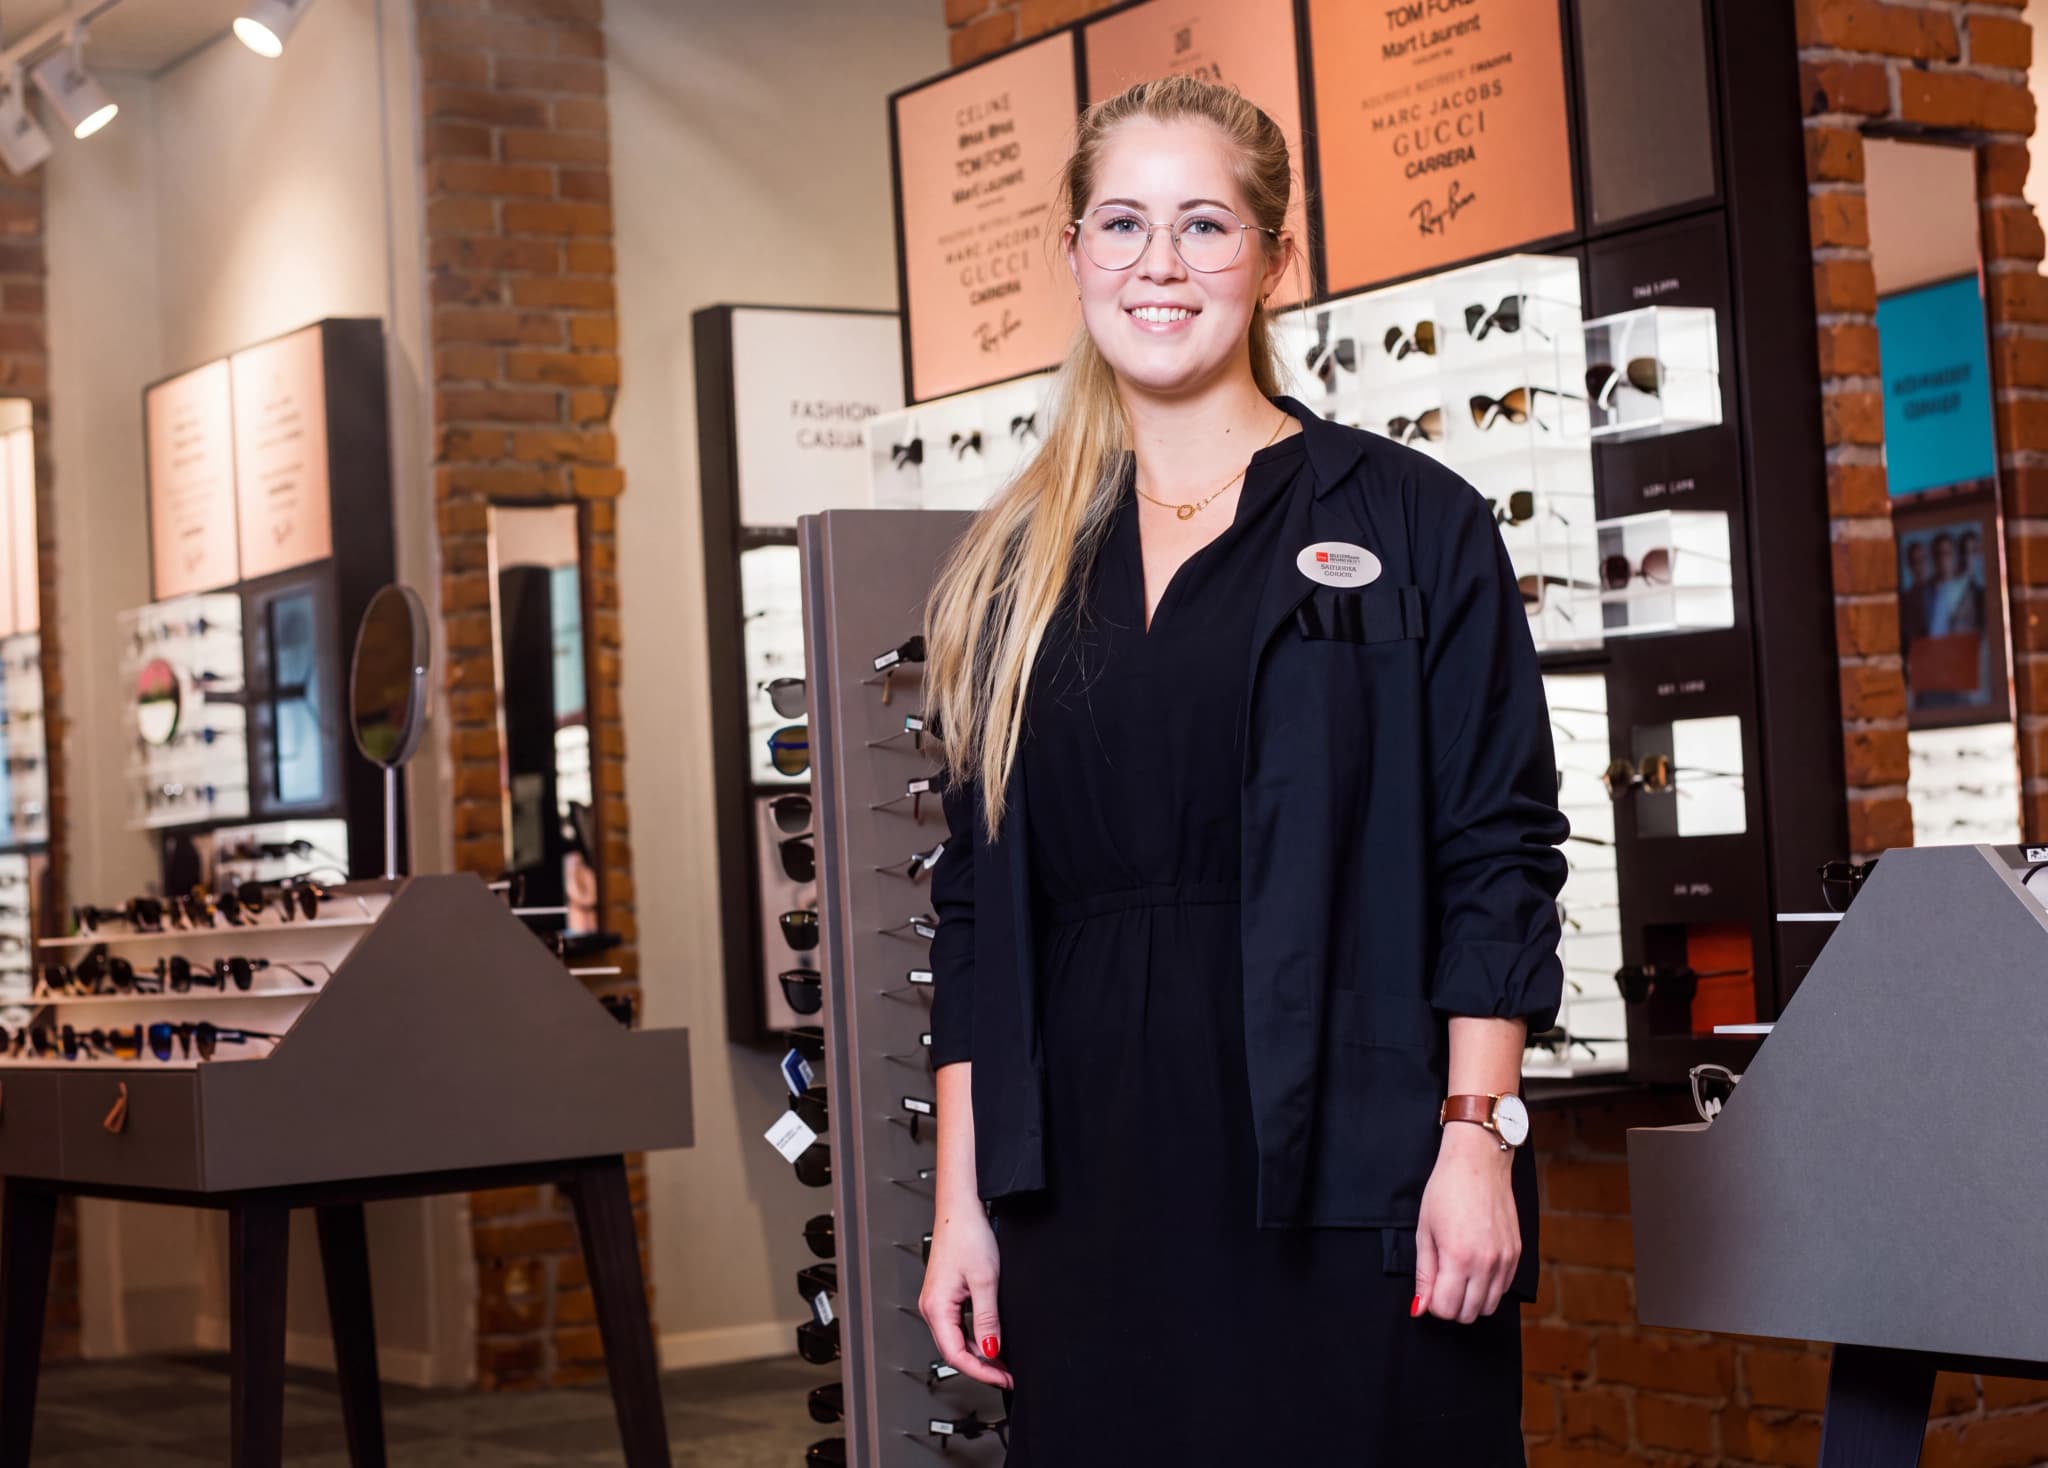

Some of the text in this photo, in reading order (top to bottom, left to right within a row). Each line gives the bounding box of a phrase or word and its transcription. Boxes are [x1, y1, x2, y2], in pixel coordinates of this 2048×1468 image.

[1385, 0, 1475, 31] TOM FO
[1371, 103, 1421, 131] MARC
[1430, 79, 1503, 117] JACOBS
[1392, 110, 1486, 158] GUCCI
[1404, 145, 1476, 179] CARRERA
[960, 250, 1029, 287] GUCCI
[790, 400, 881, 421] FASHION
[797, 428, 865, 449] CASUA
